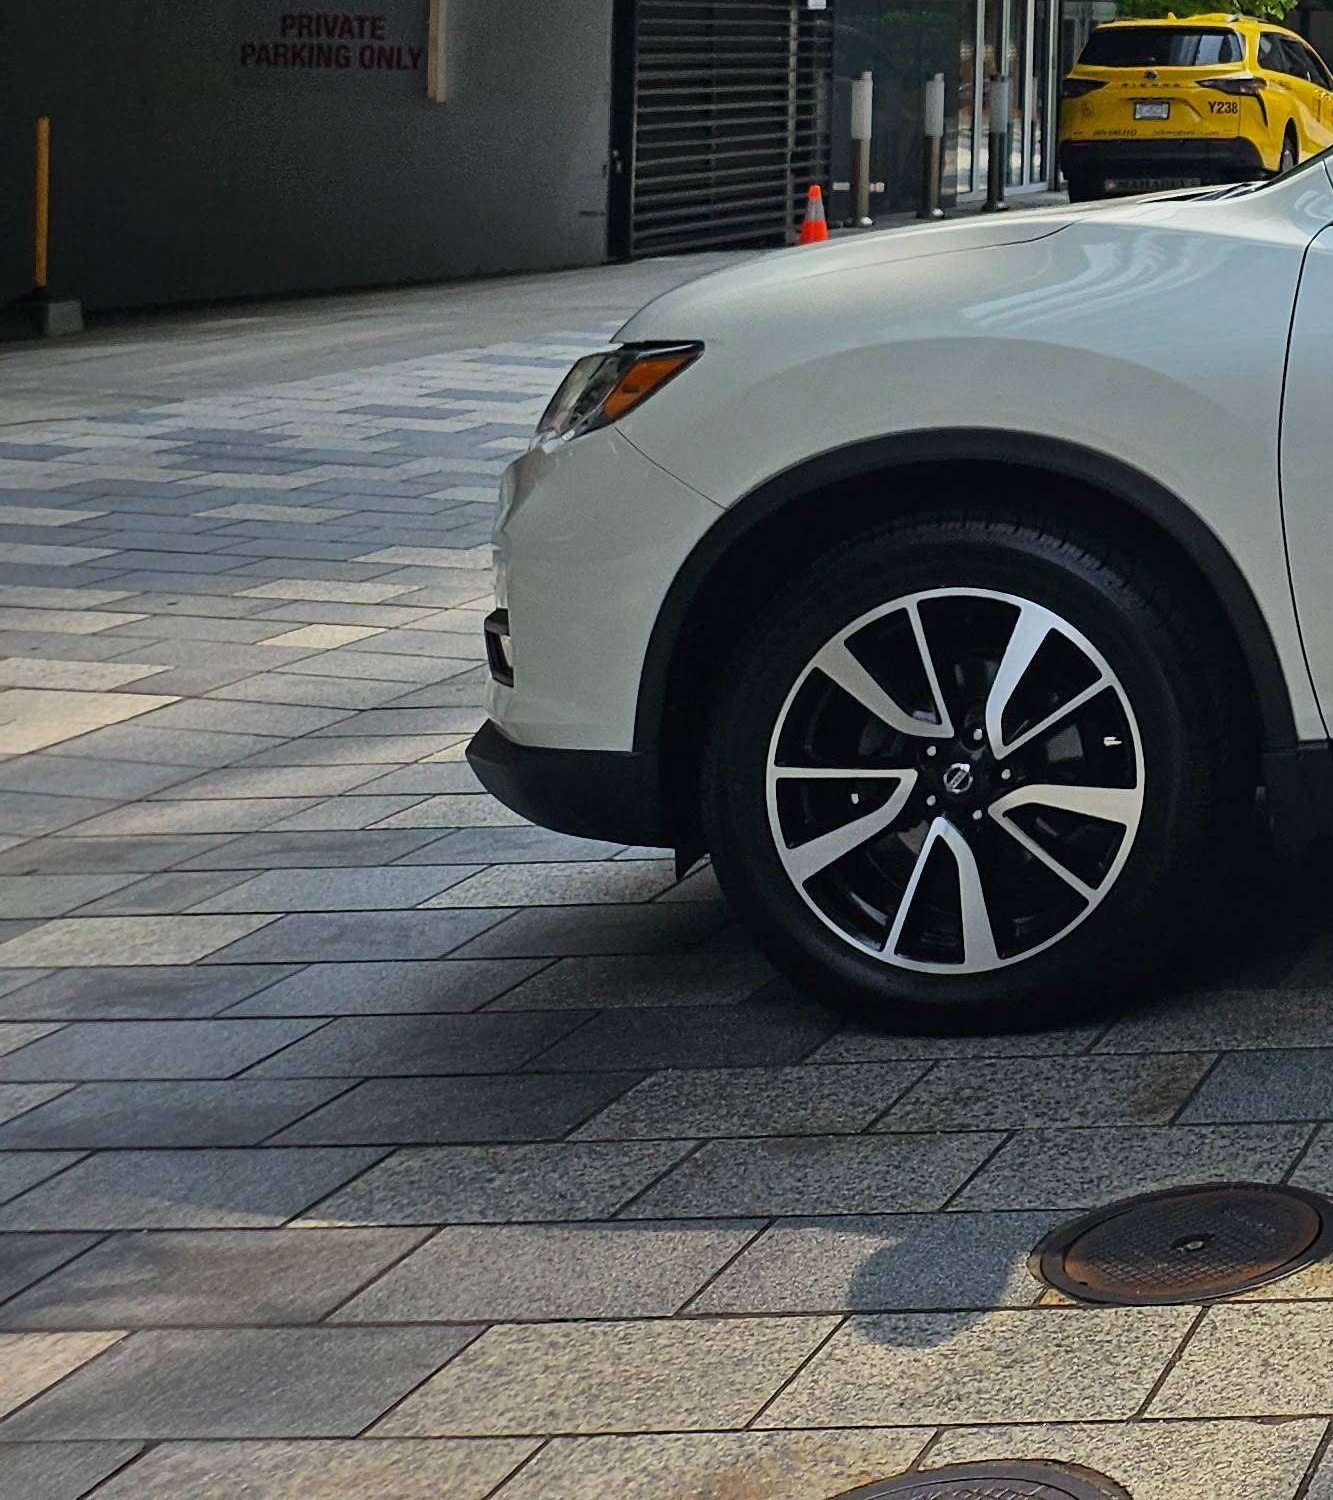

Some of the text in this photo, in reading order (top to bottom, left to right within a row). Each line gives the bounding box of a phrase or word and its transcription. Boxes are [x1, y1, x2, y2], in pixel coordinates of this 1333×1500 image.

[280, 12, 387, 41] PRIVATE
[240, 42, 422, 72] PARKING ONLY
[1208, 100, 1239, 115] Y238
